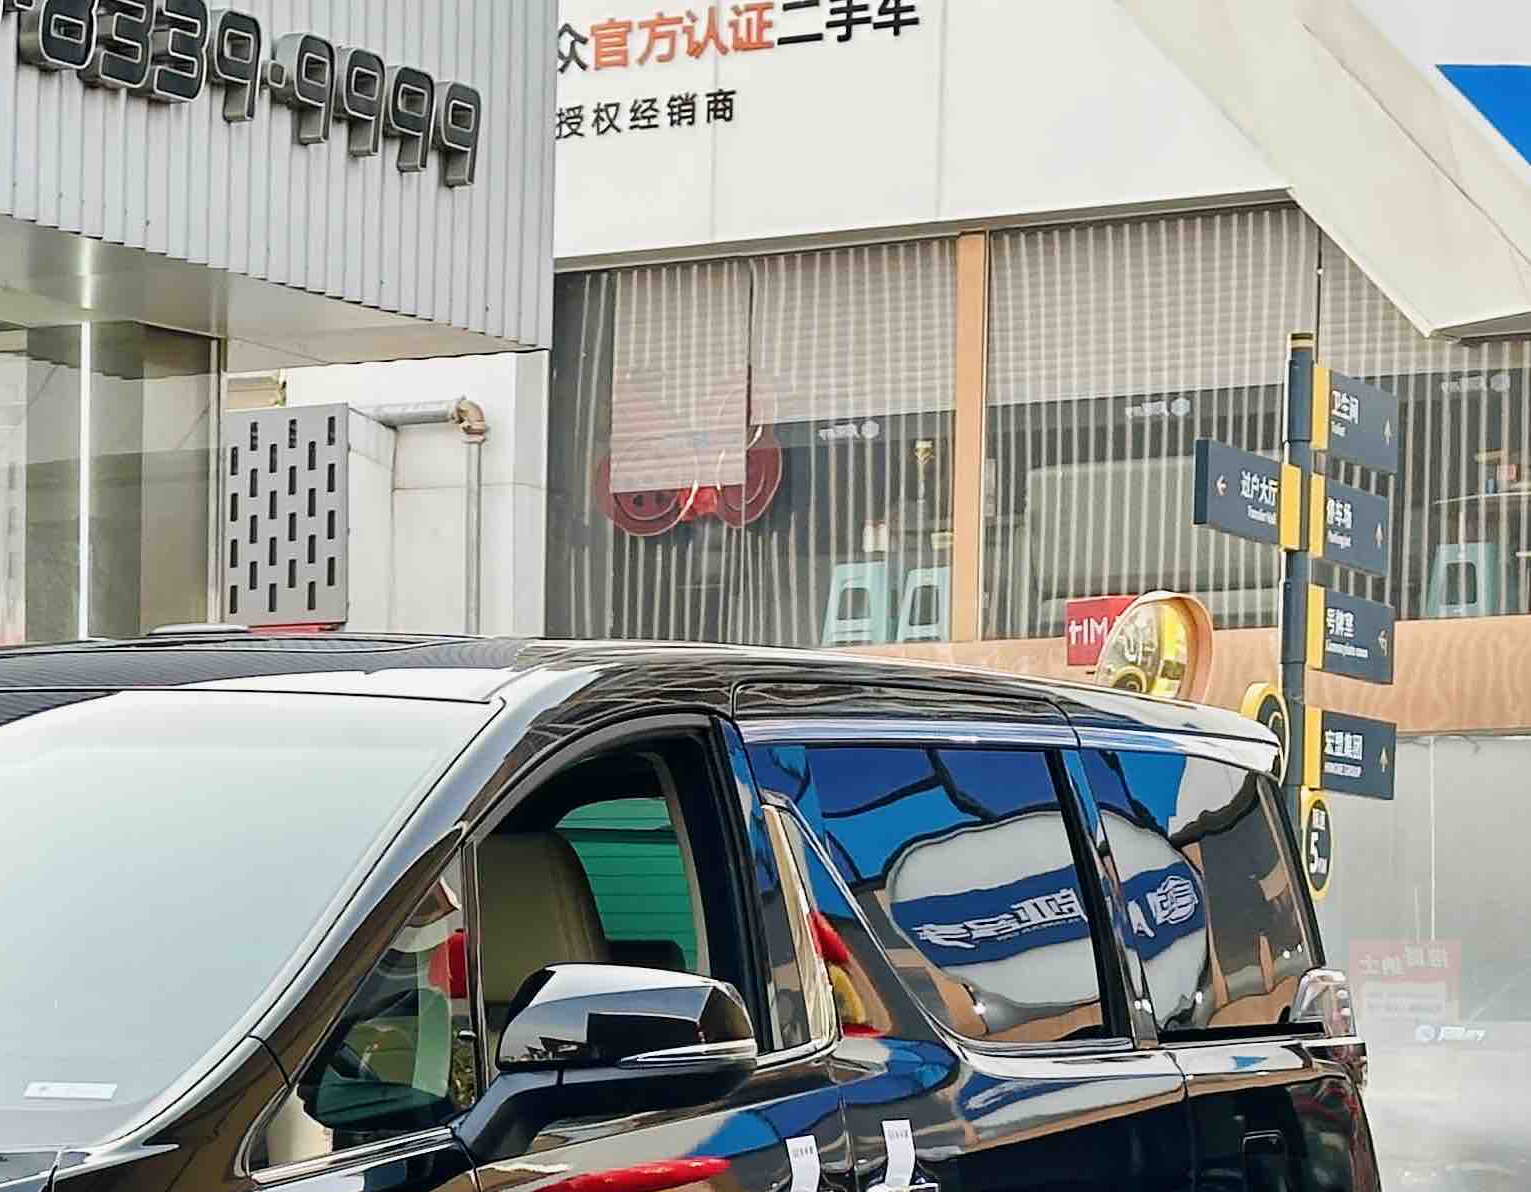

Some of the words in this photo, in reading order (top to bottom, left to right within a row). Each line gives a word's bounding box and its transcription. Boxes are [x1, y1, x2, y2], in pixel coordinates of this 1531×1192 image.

[556, 88, 737, 139] 授权经销商
[1239, 469, 1279, 507] 过户大厅
[1309, 831, 1319, 874] 5
